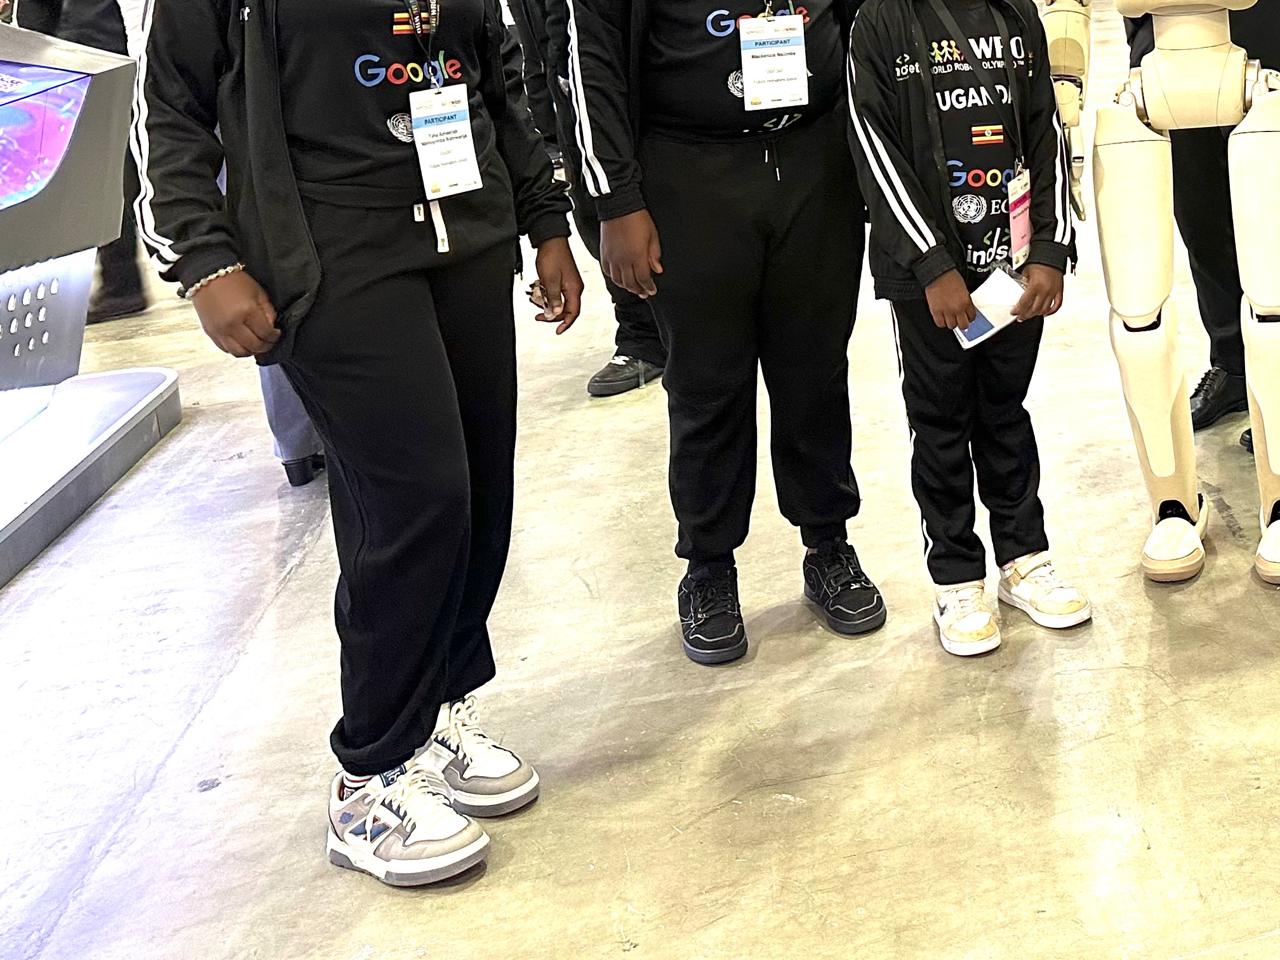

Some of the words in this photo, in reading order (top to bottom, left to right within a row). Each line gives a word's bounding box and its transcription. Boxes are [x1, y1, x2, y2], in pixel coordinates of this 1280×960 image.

[754, 38, 791, 48] PARTICIPANT
[354, 50, 462, 90] Google
[931, 63, 953, 75] ORLD
[935, 84, 1012, 112] UGAND
[424, 114, 458, 126] PARTICIPANT
[966, 227, 1012, 266] inds
